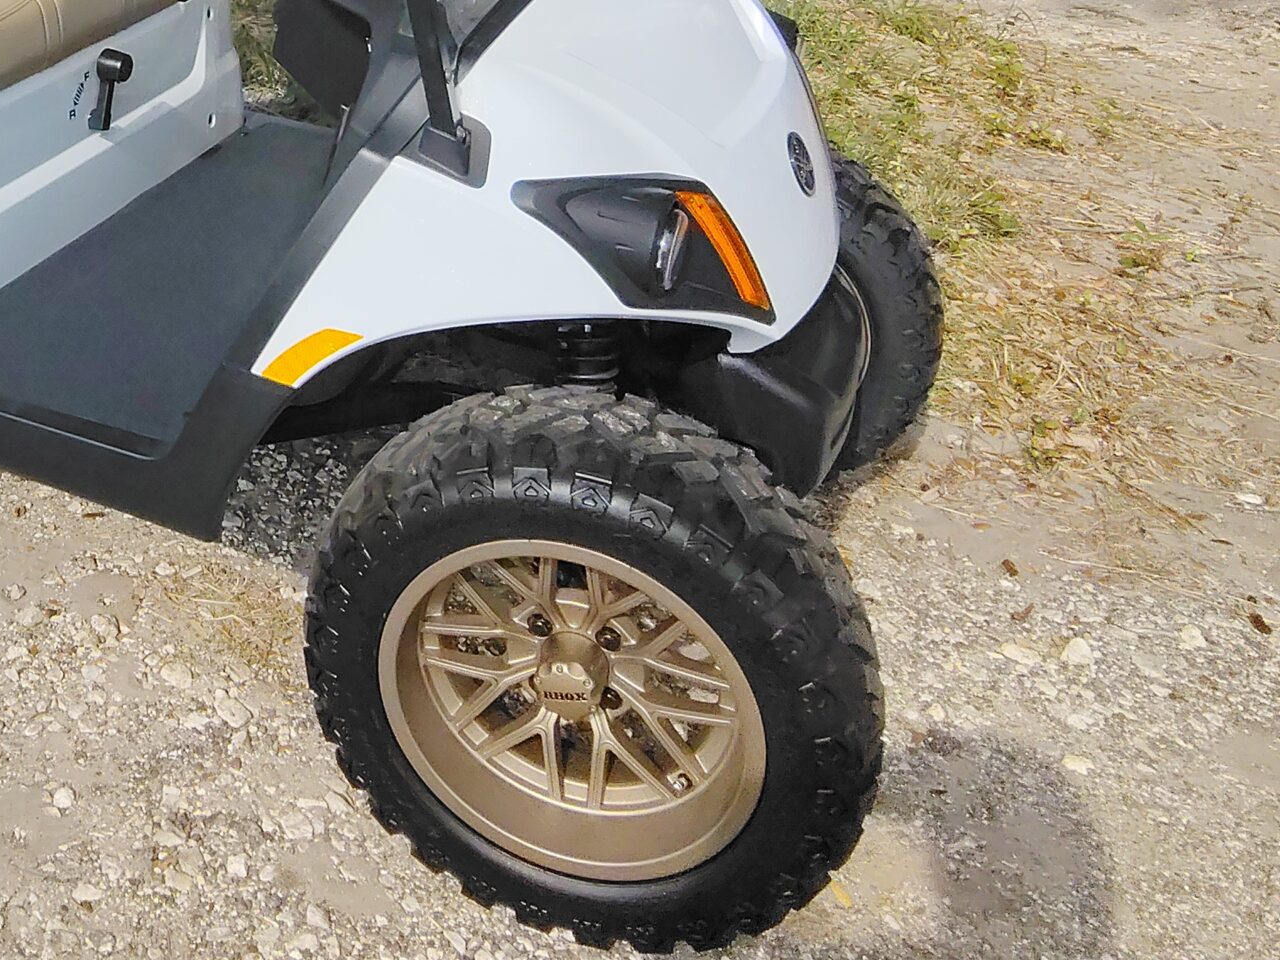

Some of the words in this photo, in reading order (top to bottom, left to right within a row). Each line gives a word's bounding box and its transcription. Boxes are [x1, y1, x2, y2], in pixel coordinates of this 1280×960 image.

[83, 70, 91, 82] F
[68, 108, 77, 120] R
[543, 690, 589, 701] RHOX
